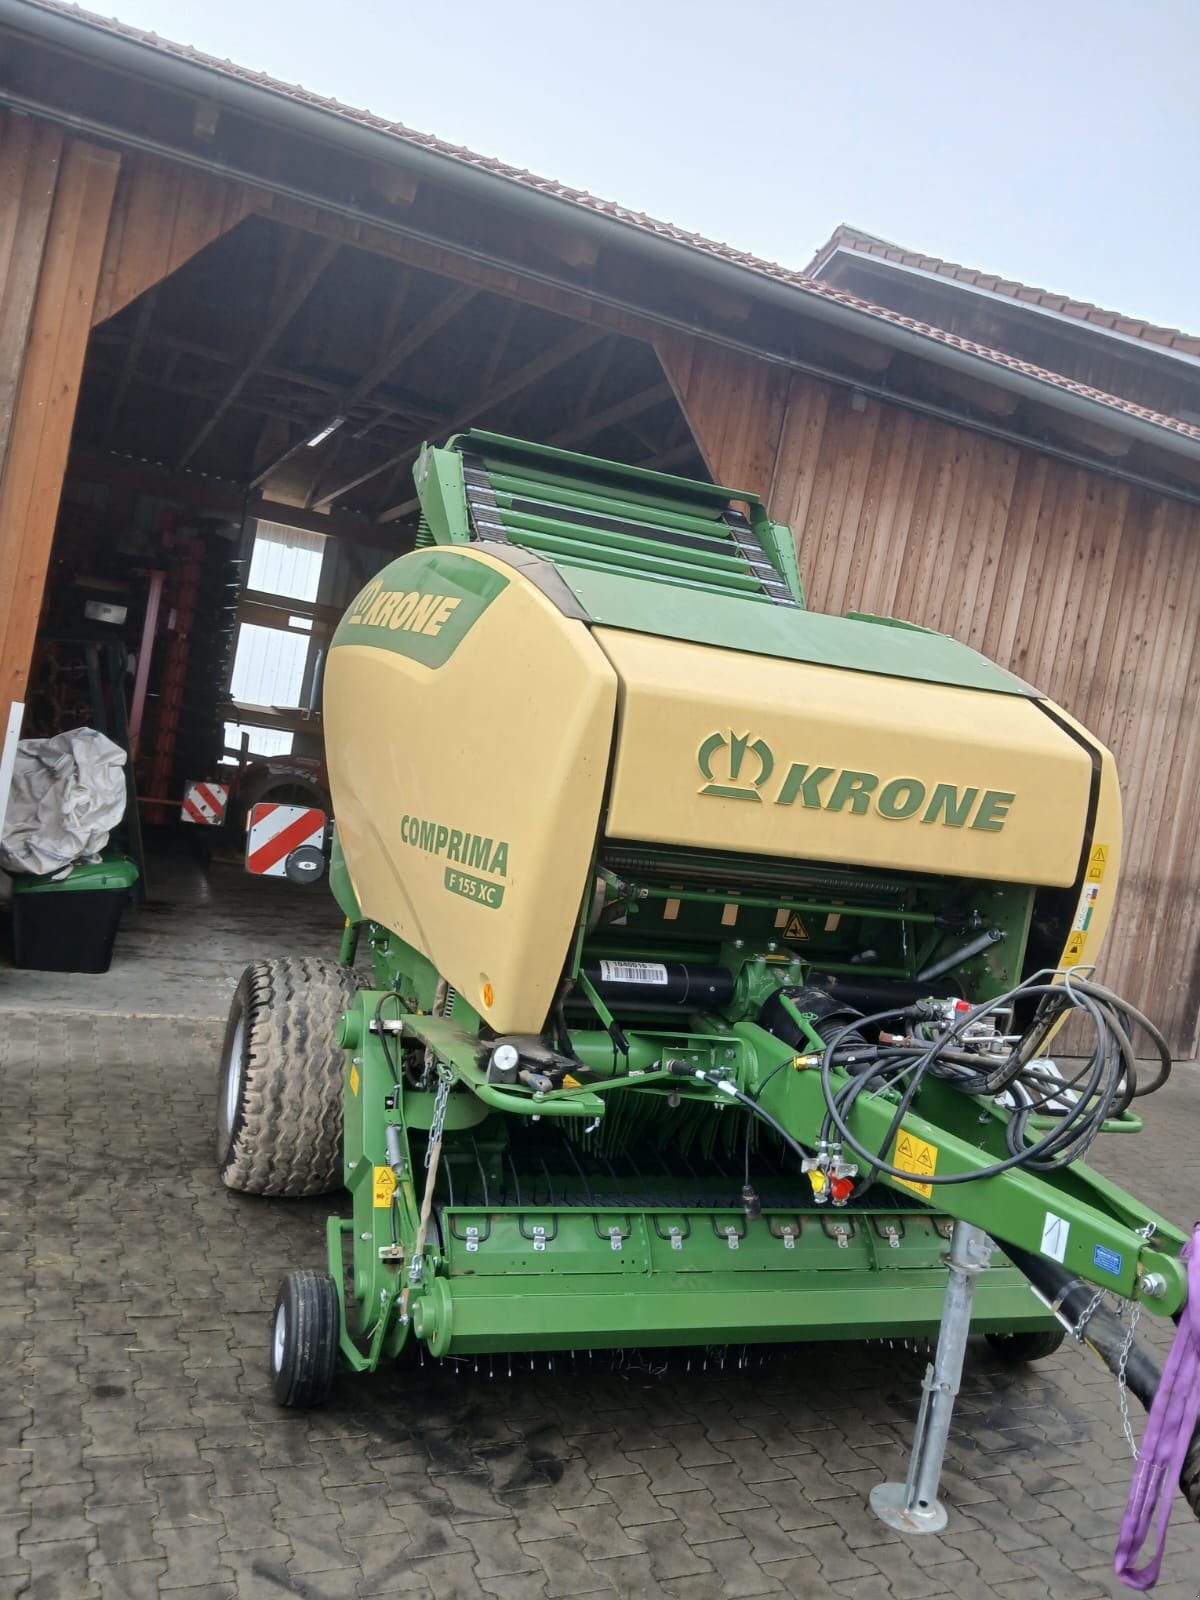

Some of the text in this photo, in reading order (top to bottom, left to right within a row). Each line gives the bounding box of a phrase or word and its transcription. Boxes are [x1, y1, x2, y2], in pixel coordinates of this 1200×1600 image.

[362, 591, 462, 637] KRONE
[774, 762, 1016, 832] KRONE
[401, 815, 509, 877] COMPRIMA
[449, 873, 497, 904] F 155 XC
